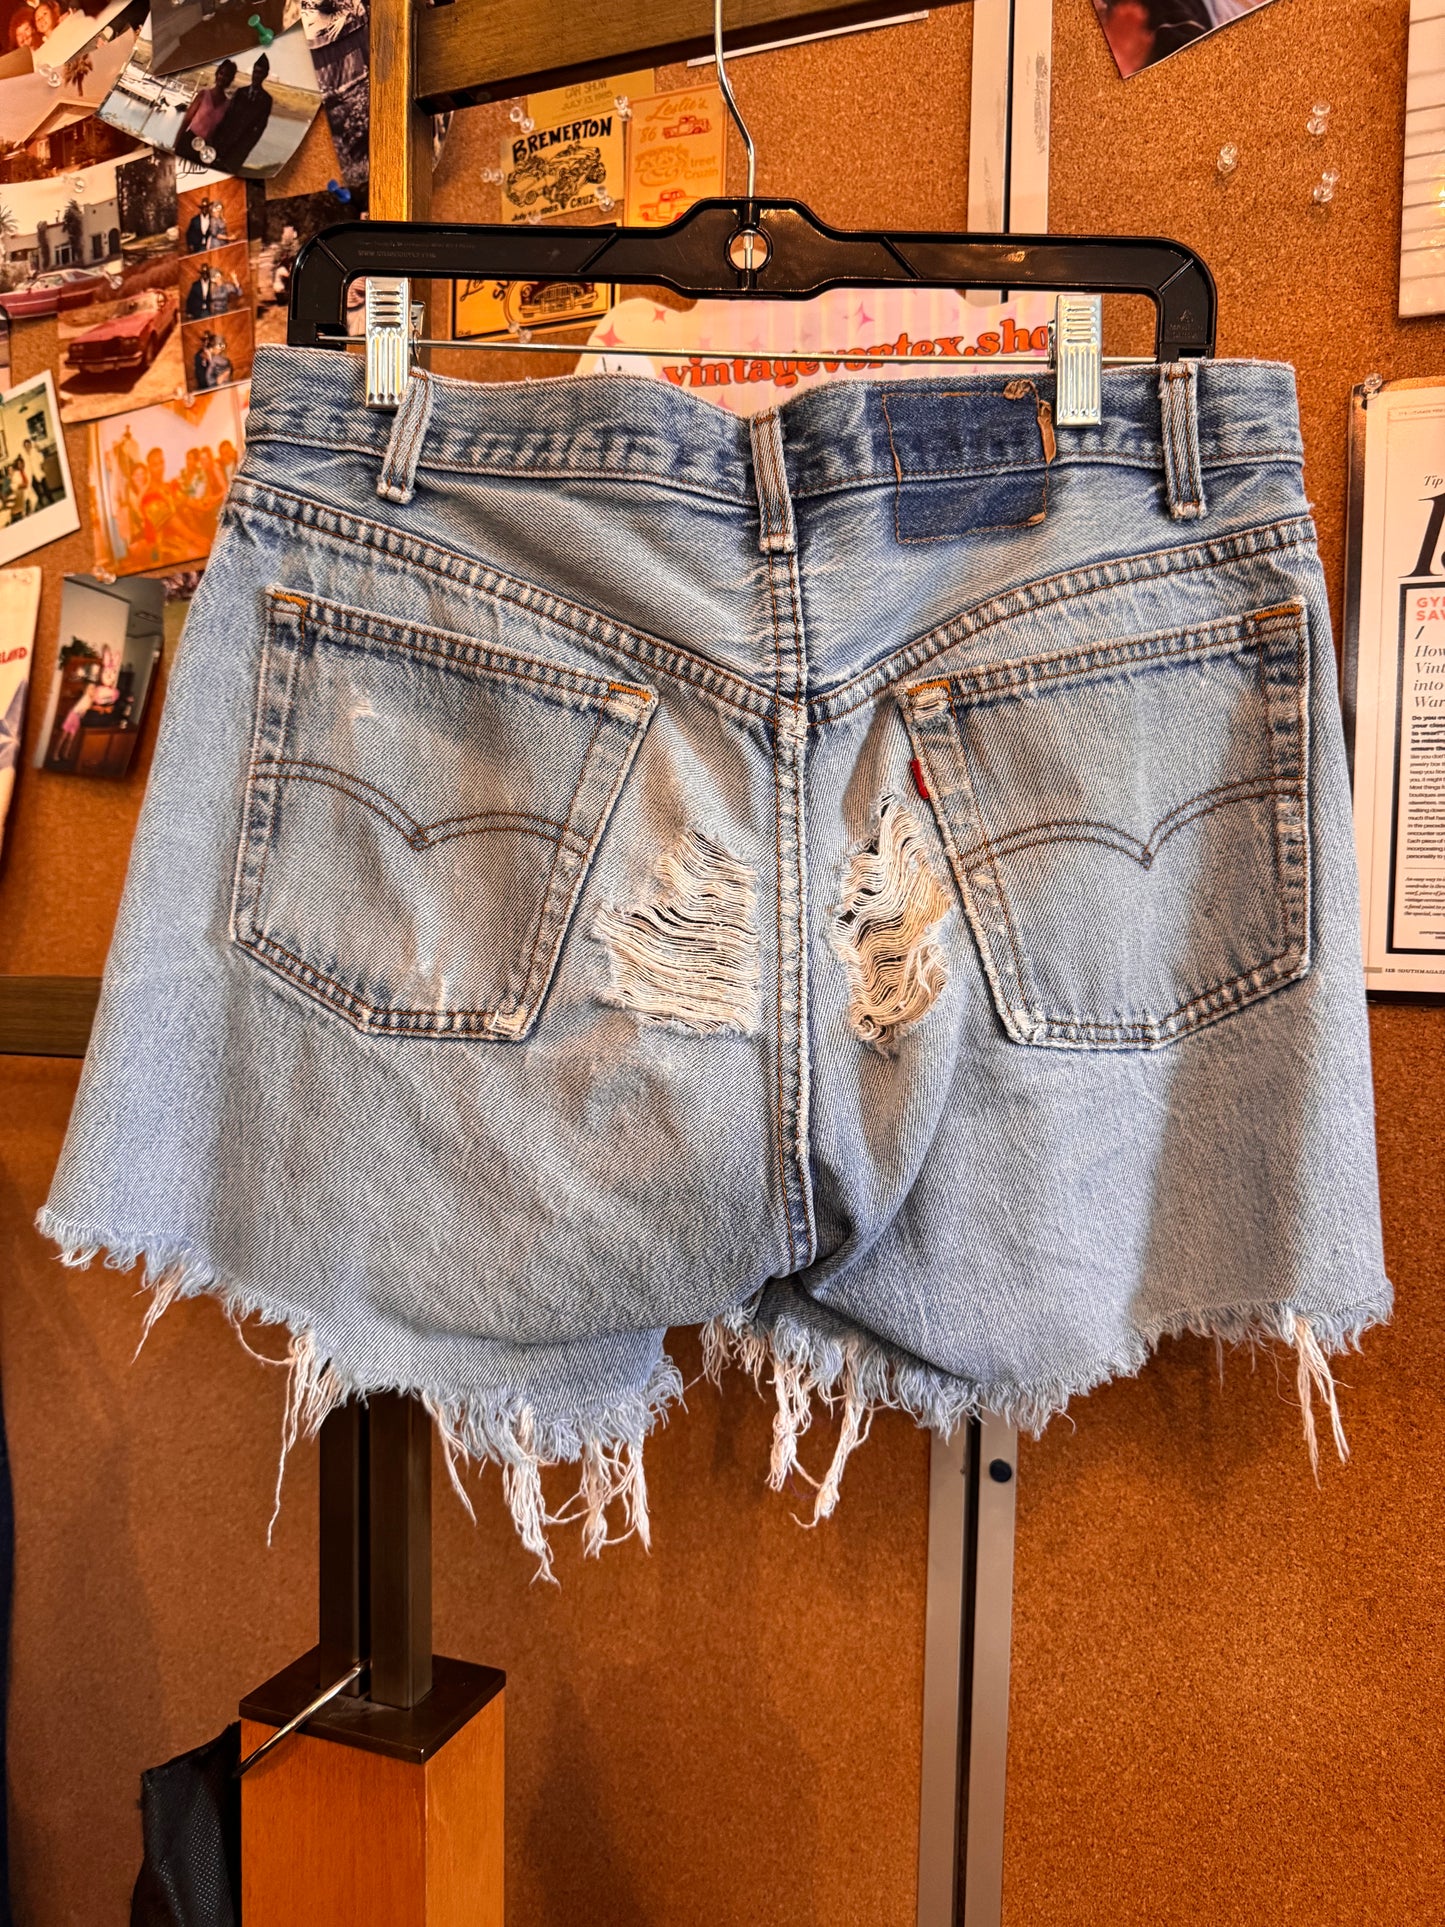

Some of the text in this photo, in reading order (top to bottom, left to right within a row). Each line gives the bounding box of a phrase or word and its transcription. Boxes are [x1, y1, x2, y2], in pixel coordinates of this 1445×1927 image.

[512, 116, 612, 163] BREMERTON
[663, 319, 1048, 387] vintagevortex.sho
[1424, 474, 1444, 488] Tip
[1413, 680, 1444, 691] into
